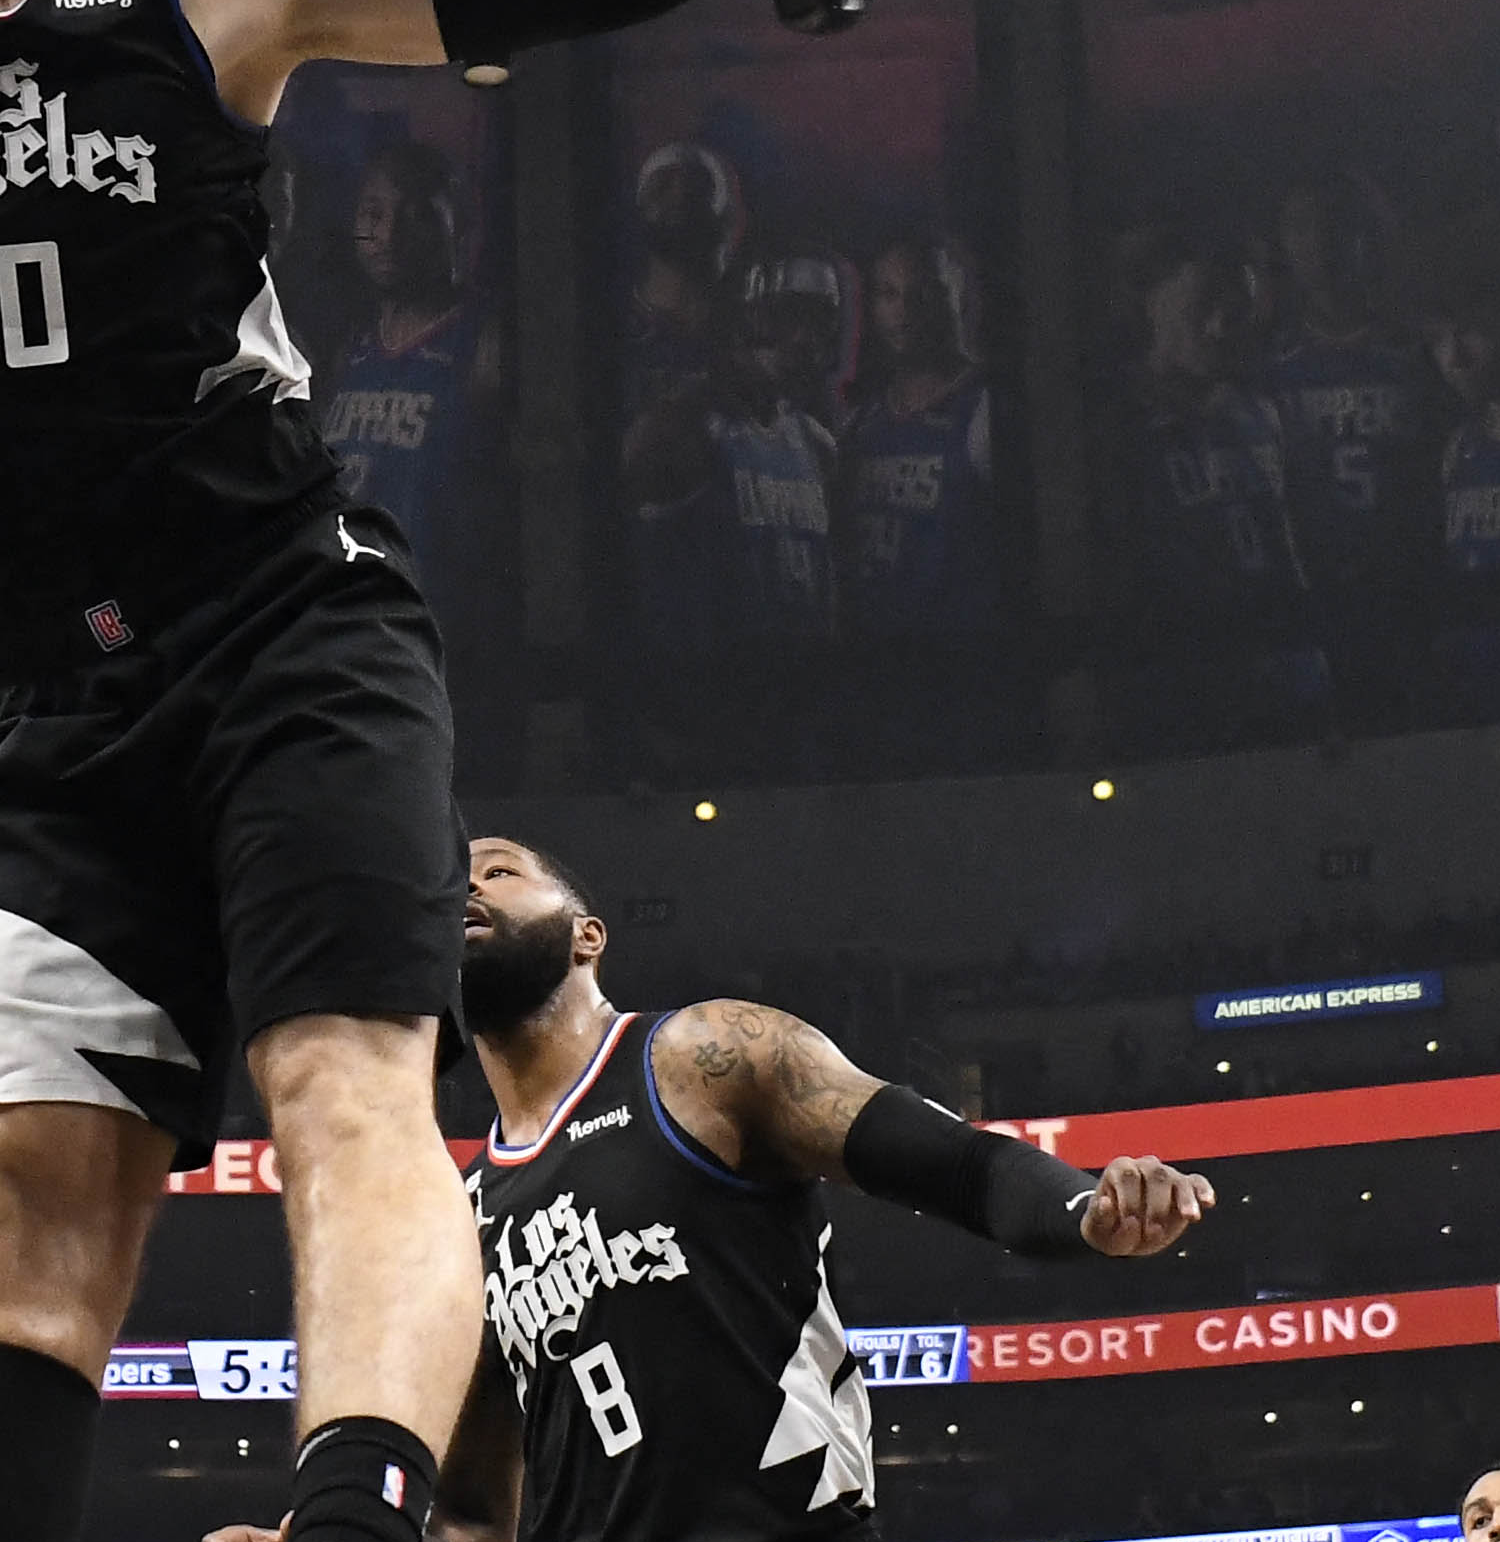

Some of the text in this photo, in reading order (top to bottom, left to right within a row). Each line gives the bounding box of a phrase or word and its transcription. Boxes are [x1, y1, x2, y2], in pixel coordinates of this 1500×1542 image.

[1214, 981, 1422, 1020] AMERICAN EXPRESS
[566, 1104, 633, 1141] honey
[501, 1192, 584, 1282] Los
[484, 1223, 689, 1414] Angeles
[968, 1322, 1162, 1370] RESORT
[1195, 1302, 1400, 1353] CASINO
[855, 1333, 943, 1352] FOULS TOL
[869, 1352, 944, 1379] 1 6
[220, 1348, 297, 1395] 5:5
[571, 1342, 642, 1457] 8
